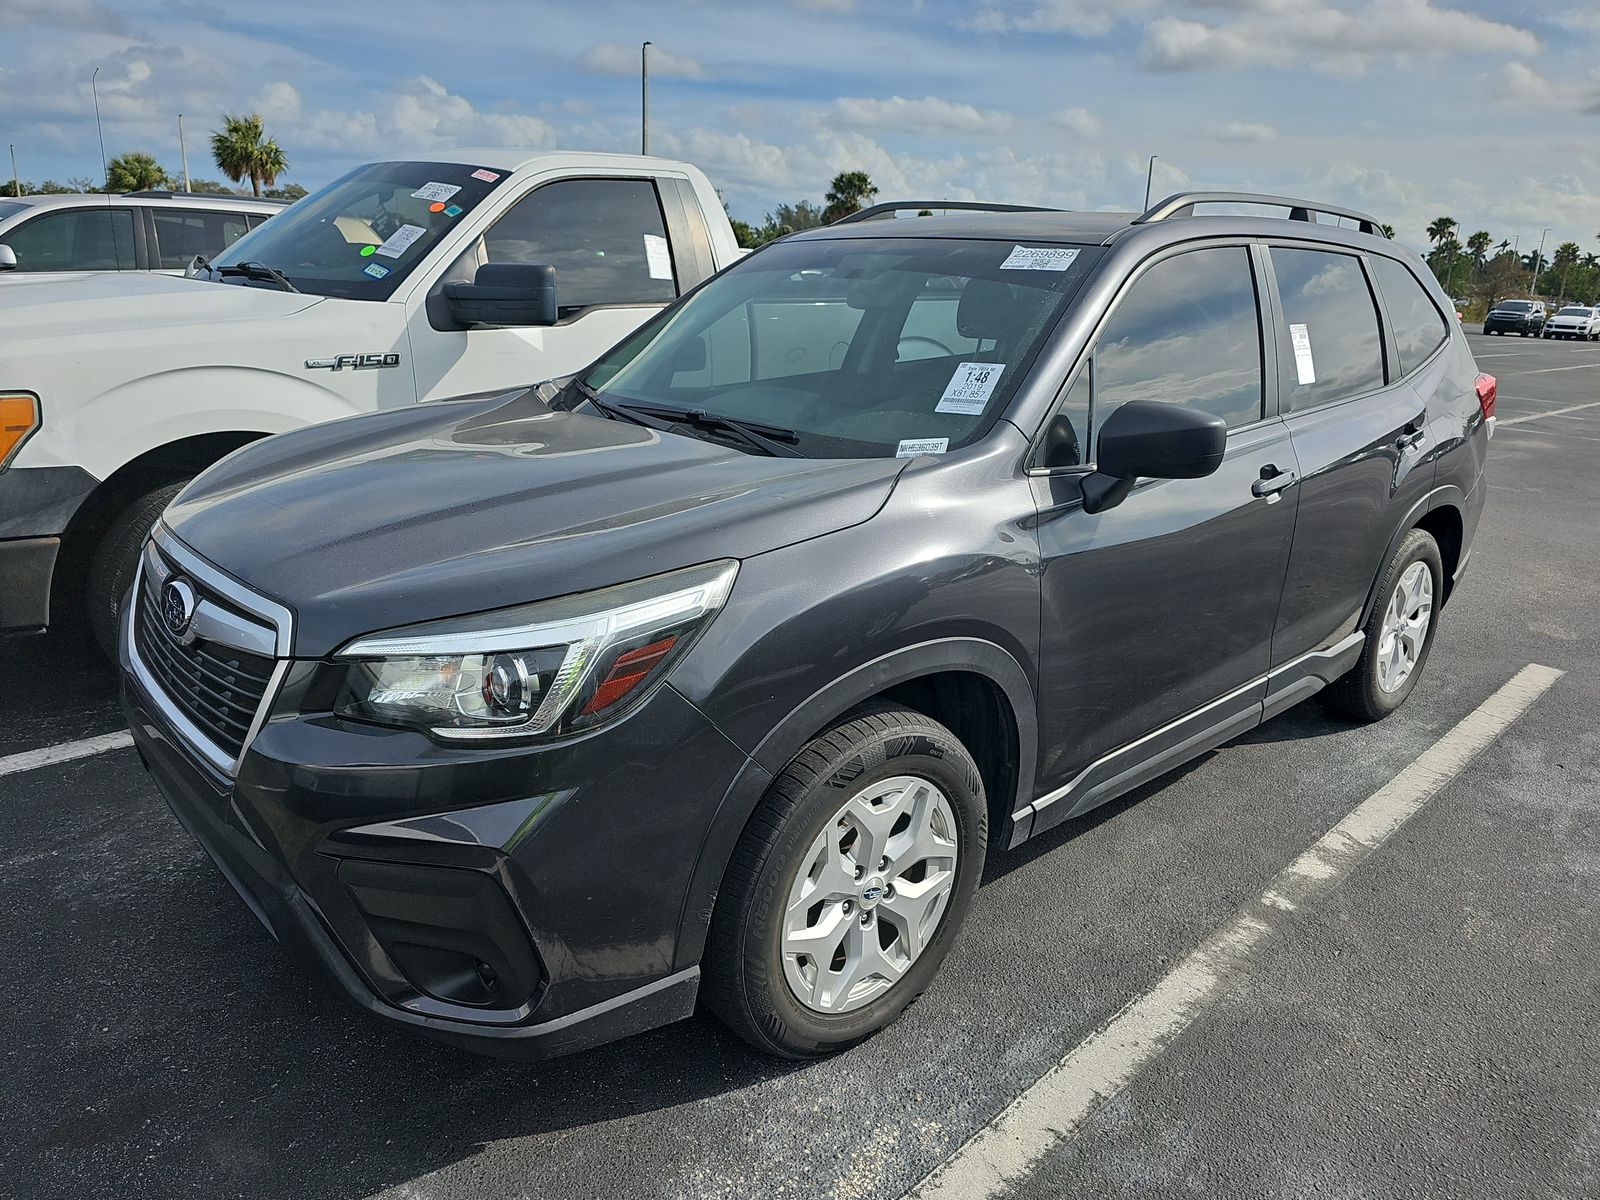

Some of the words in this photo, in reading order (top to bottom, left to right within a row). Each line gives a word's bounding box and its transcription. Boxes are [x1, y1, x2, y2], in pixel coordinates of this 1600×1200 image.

[1013, 249, 1075, 259] 2269899
[331, 353, 400, 371] F-150
[964, 370, 991, 384] 1:48
[961, 382, 984, 391] 2019
[950, 388, 986, 399] X81,857
